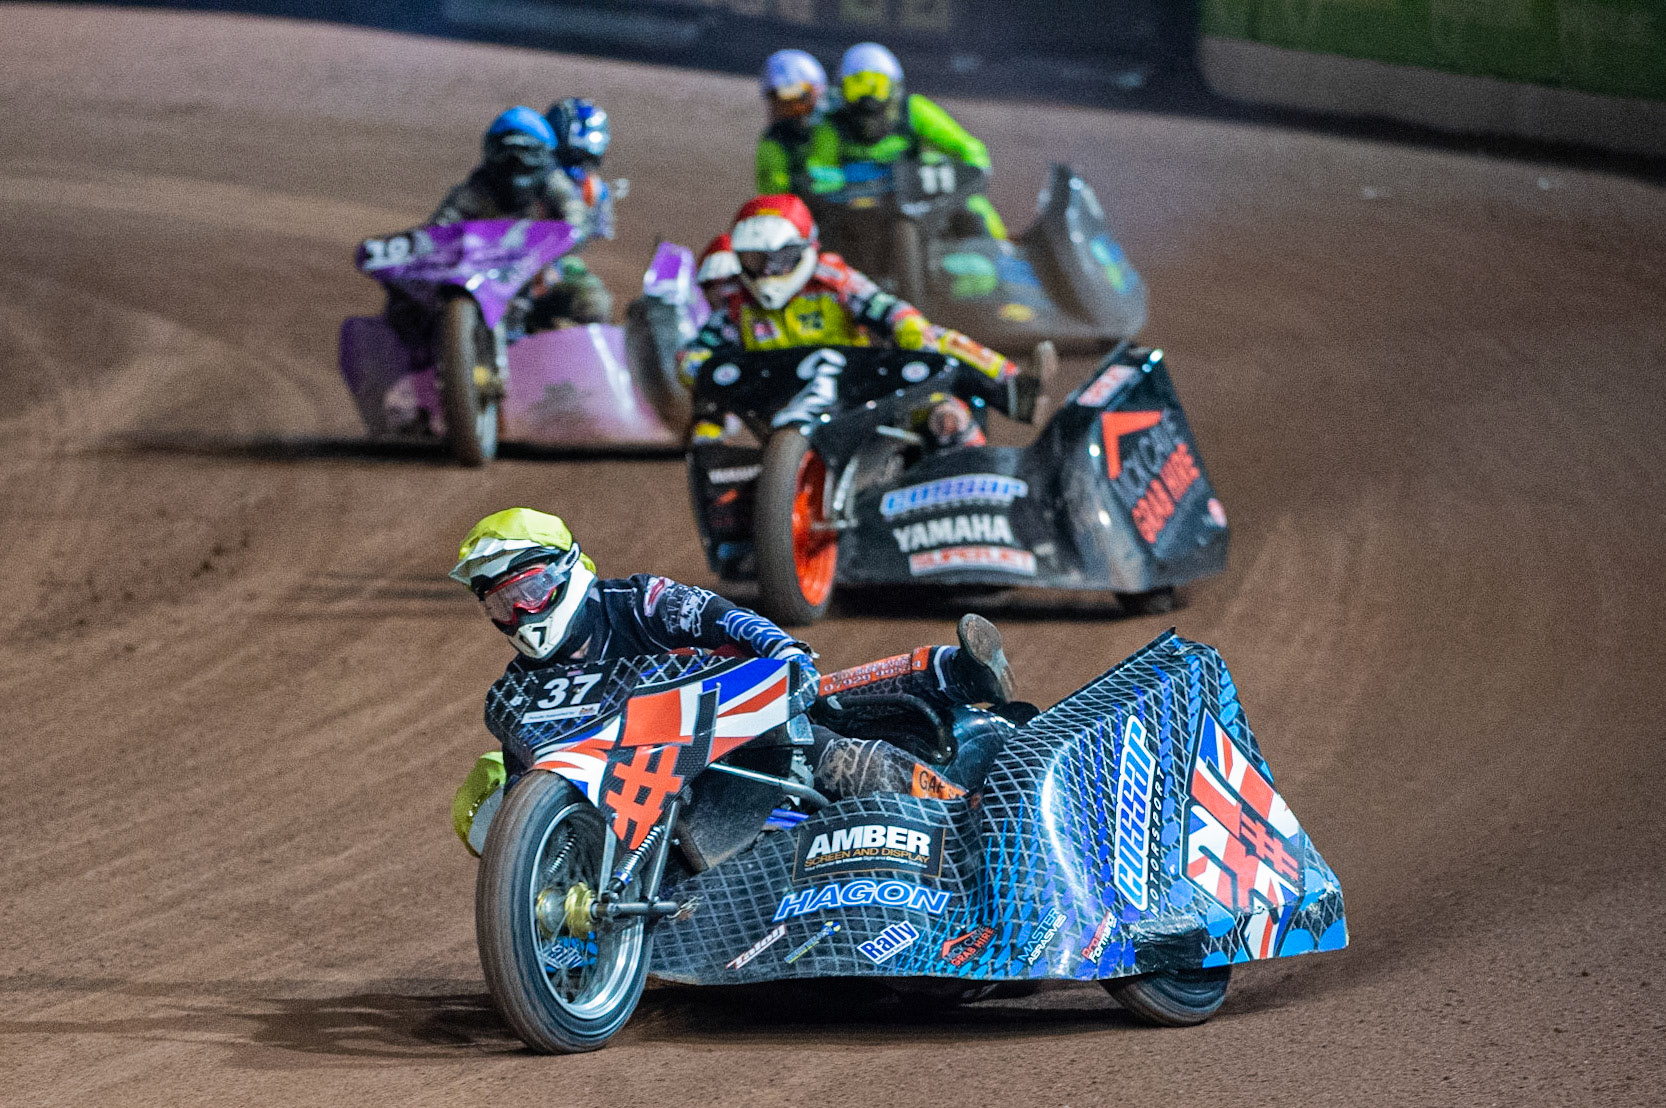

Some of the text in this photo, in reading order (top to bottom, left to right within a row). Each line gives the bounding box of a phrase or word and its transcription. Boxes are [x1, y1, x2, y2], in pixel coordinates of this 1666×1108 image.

[893, 514, 1014, 552] YAMAHA
[537, 673, 602, 709] 37
[804, 850, 851, 867] SCREEN
[853, 847, 879, 857] AND
[881, 847, 930, 864] DISPLAY
[806, 825, 931, 860] AMBER
[1149, 767, 1165, 917] MOTORSPORT
[774, 880, 951, 921] HAGON
[858, 921, 917, 961] Rally
[950, 926, 994, 966] GRAB HIRE
[1016, 907, 1060, 961] MASTER
[1027, 913, 1067, 965] ABRASIVES
